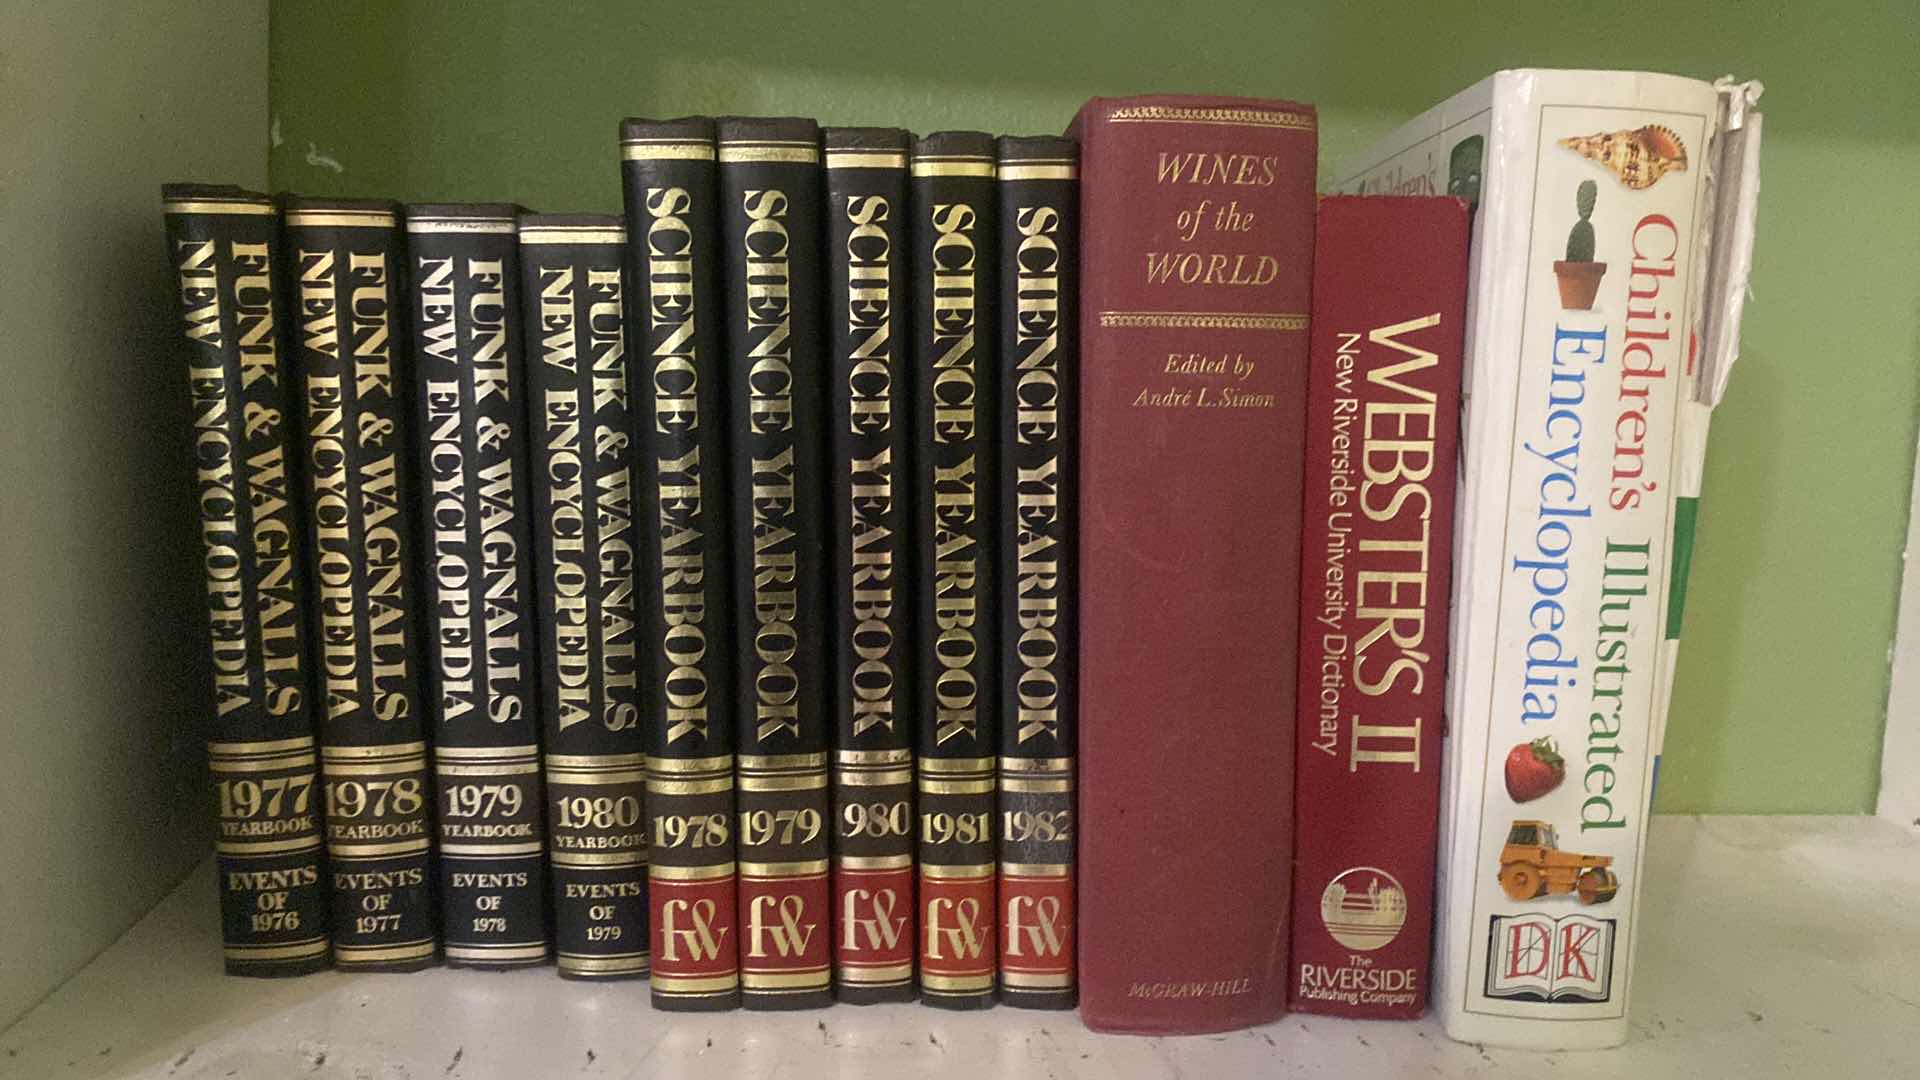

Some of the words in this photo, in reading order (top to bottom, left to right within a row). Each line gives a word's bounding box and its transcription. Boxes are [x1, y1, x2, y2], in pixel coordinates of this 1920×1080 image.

[1157, 152, 1278, 186] WINES
[1176, 200, 1212, 241] of
[1215, 201, 1255, 232] the
[178, 239, 223, 350] NEW
[1147, 253, 1280, 286] WORLD
[232, 241, 279, 390] FUNK
[299, 249, 339, 360] NEW
[350, 252, 392, 400] FUNK
[419, 257, 458, 365] NEW
[469, 259, 509, 402] FUNK
[539, 266, 577, 375] NEW
[647, 187, 698, 434] SCIENCE
[744, 190, 793, 434] SCIENCE
[847, 195, 890, 435] SCIENCE
[933, 204, 976, 444] SCIENCE
[1017, 207, 1058, 444] SCIENCE
[587, 268, 627, 414] FUNK
[1163, 354, 1229, 374] Edited
[1234, 354, 1255, 380] by
[1335, 333, 1361, 392] New
[1608, 214, 1679, 511] Children's
[244, 402, 281, 440] &
[1132, 387, 1193, 408] André
[358, 411, 394, 449] &
[476, 416, 511, 453] &
[595, 425, 629, 462] &
[1329, 398, 1357, 507] Riverside
[1353, 313, 1441, 695] WEBSTER'S
[1513, 322, 1608, 725] Encyclopedia
[190, 365, 251, 717] ENCYCLOPEDIA
[308, 374, 360, 720] ENCYCLOPEDIA
[427, 380, 475, 722] ENCYCLOPEDIA
[545, 389, 591, 732] ENCYCLOPEDIA
[1316, 510, 1353, 629] University
[246, 445, 301, 717] WAGNALLS
[360, 455, 409, 721] WAGNALLS
[477, 458, 522, 723] WAGNALLS
[596, 466, 638, 732] WAGNALLS
[658, 444, 708, 745] YEARBOOK
[752, 445, 799, 744] YEARBOOK
[851, 446, 894, 737] YEARBOOK
[935, 453, 977, 747] YEARBOOK
[1017, 455, 1059, 745] YEARBOOK
[1312, 634, 1348, 756] Dictionary
[1580, 536, 1652, 833] Illustrated
[1351, 715, 1422, 773] II
[216, 774, 315, 818] 1977
[325, 778, 424, 818] 1978
[446, 784, 523, 819] 1979
[557, 796, 640, 829] 1980
[841, 801, 911, 837] 980
[222, 817, 314, 836] YEARBOOK
[442, 823, 532, 838] YEARBOOK
[654, 814, 729, 848] 1978
[740, 808, 822, 846] 1979
[918, 812, 989, 844] 1981
[1003, 809, 1072, 842] 1982
[229, 865, 318, 890] EVENTS
[257, 892, 289, 911] OF
[336, 868, 423, 890] EVENTS
[362, 894, 392, 912] OF
[452, 872, 528, 888] EVENTS
[476, 896, 502, 911] OF
[566, 882, 640, 898] EVENTS
[252, 912, 300, 932] 1976
[355, 915, 402, 934] 1977
[472, 918, 507, 932] 1978
[586, 927, 622, 941] 1979
[589, 906, 616, 920] OF
[1300, 964, 1417, 991] RIVERSIDE
[1350, 955, 1373, 967] The
[1504, 921, 1601, 983] DK
[1300, 985, 1359, 1006] Publishing
[1360, 990, 1417, 1006] Company
